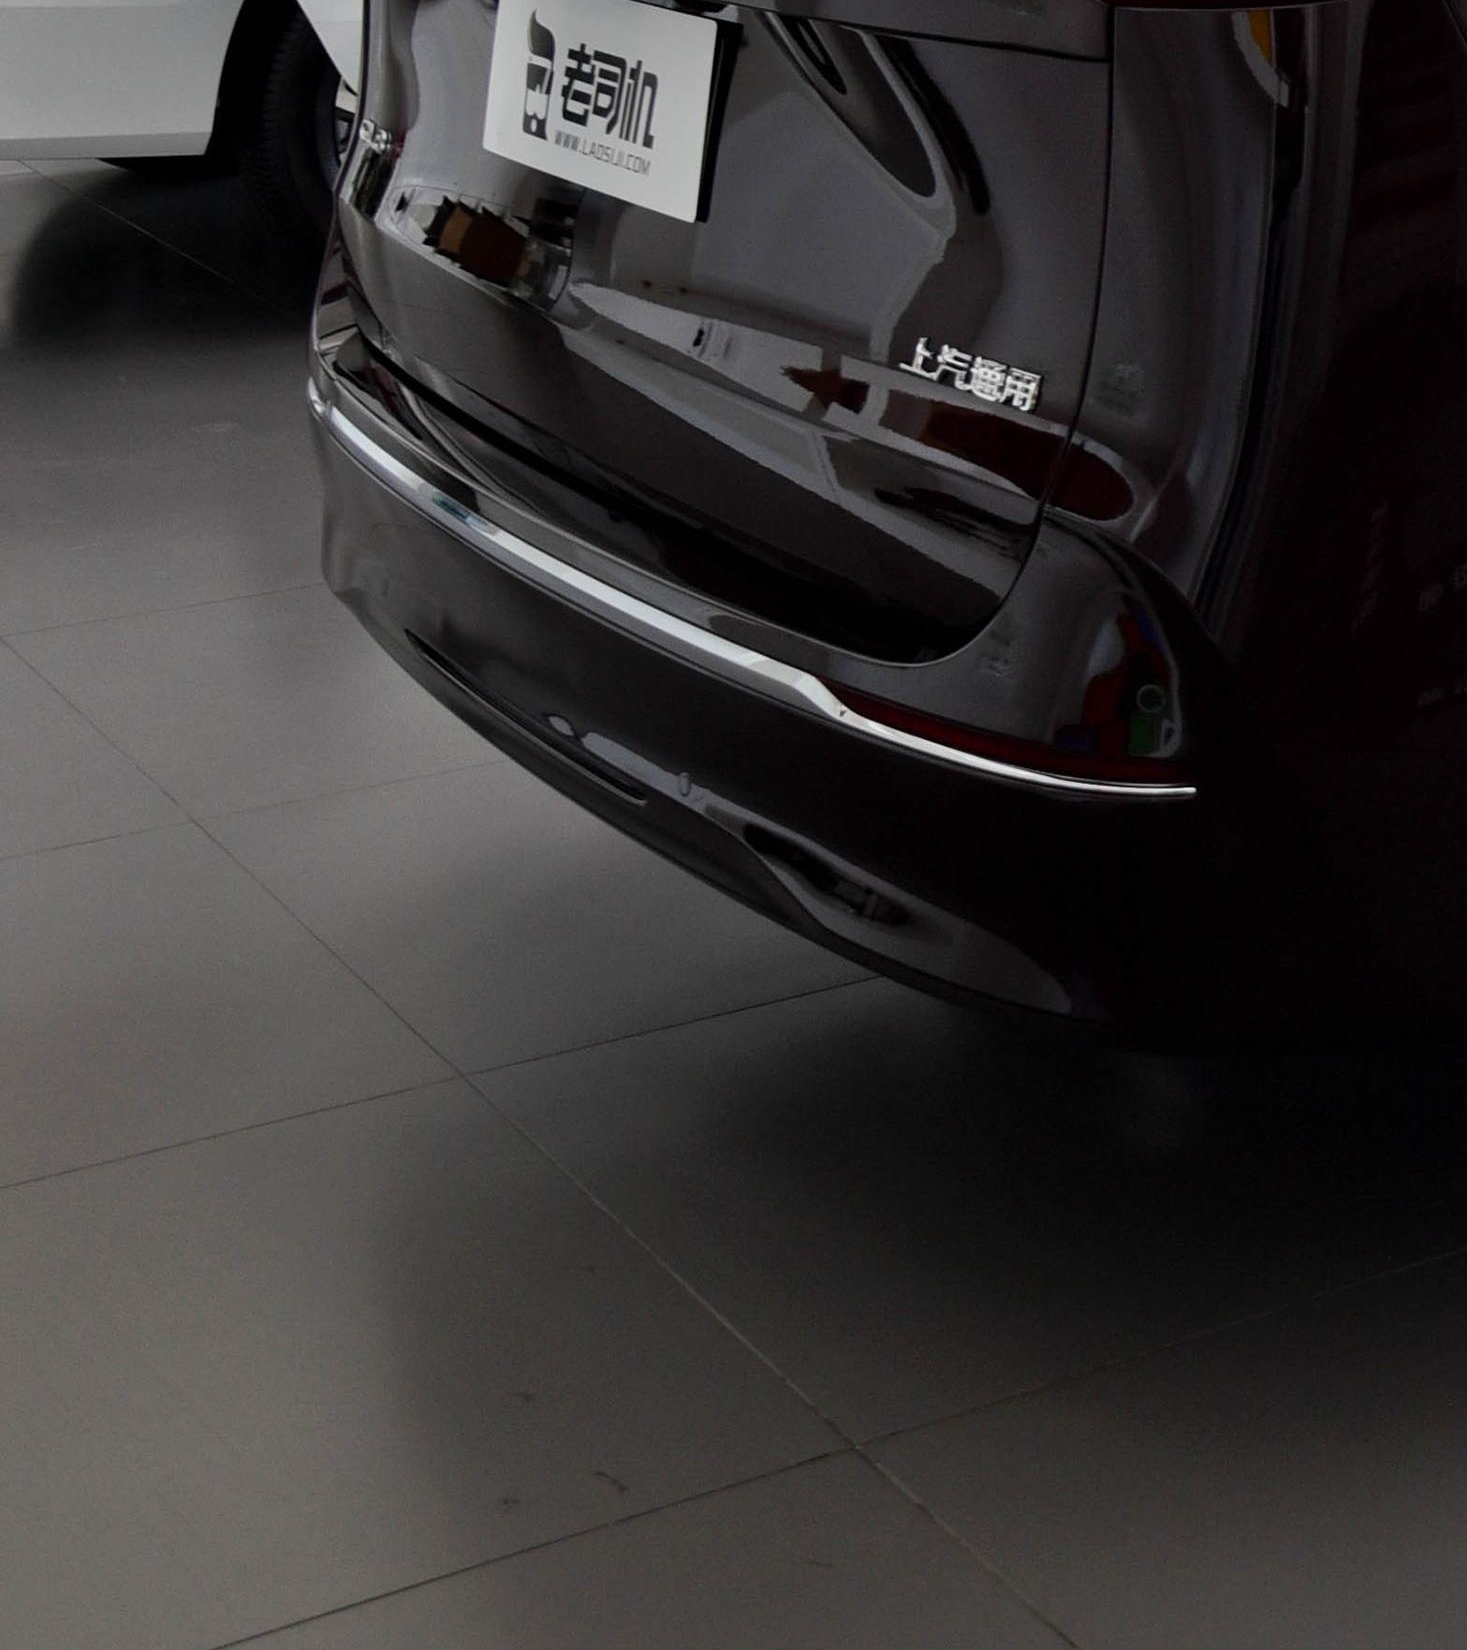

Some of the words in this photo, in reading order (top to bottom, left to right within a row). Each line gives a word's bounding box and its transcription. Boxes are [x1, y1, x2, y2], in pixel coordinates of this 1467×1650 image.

[561, 43, 659, 150] 老司机
[899, 337, 1043, 412] 上汽通用
